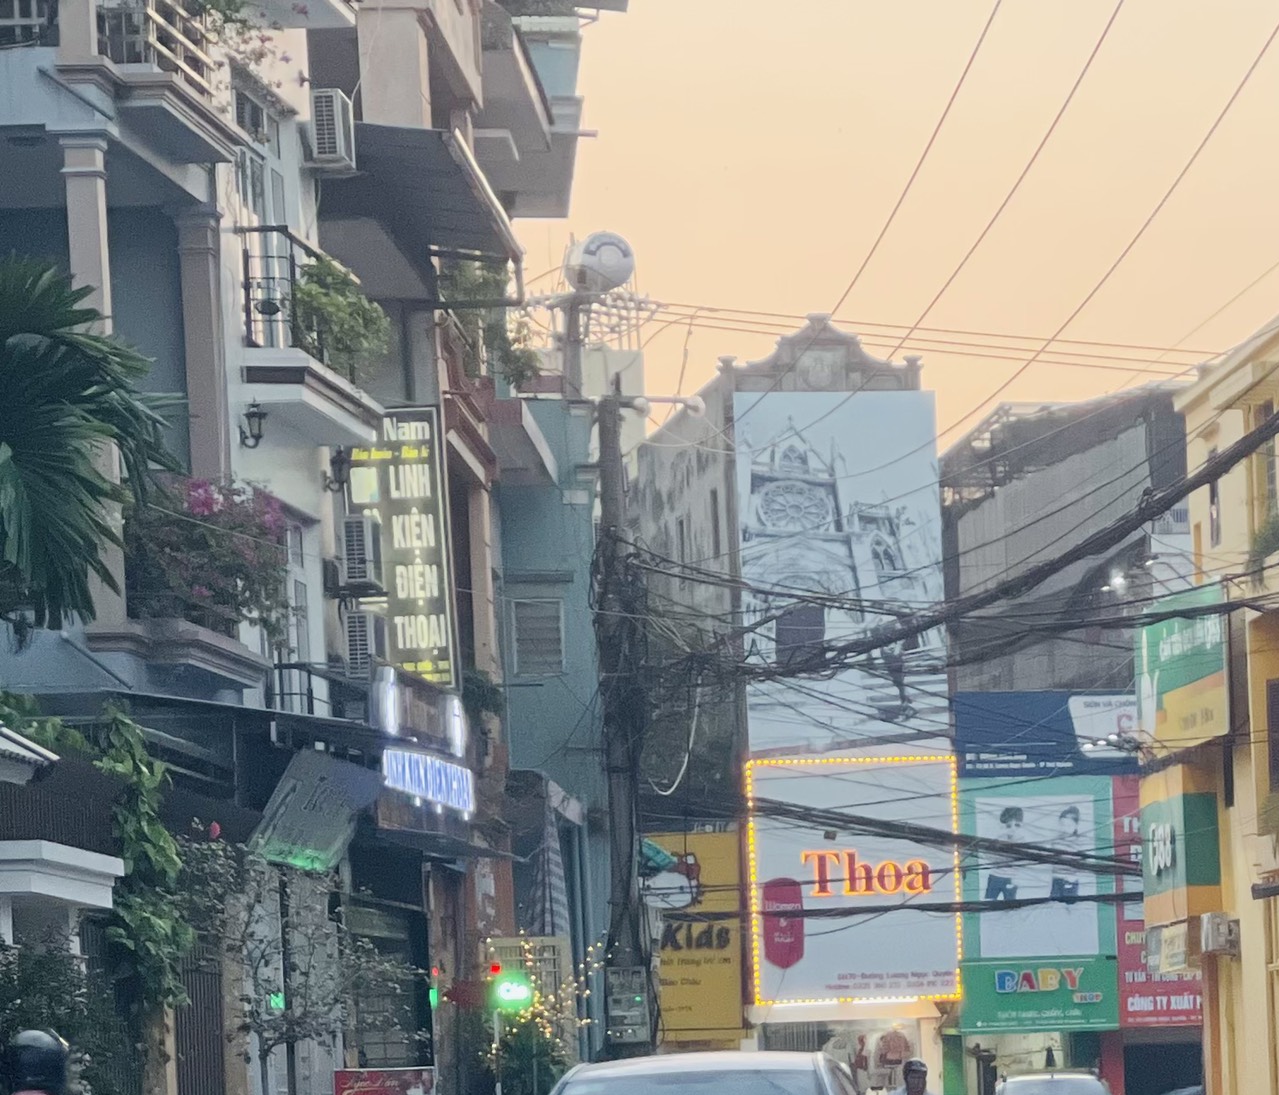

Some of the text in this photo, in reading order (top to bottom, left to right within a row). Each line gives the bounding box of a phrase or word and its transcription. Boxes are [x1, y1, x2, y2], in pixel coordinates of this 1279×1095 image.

[383, 417, 431, 441] Nam
[389, 464, 431, 499] LINH
[392, 507, 435, 555] KIỆN
[396, 558, 438, 606] ĐIỆN
[394, 613, 446, 655] THOẠI
[801, 851, 932, 897] Thoa
[661, 923, 730, 950] Kids
[995, 967, 1084, 993] BABY
[1127, 993, 1154, 1012] CÔNG
[1155, 995, 1168, 1011] TY
[1170, 991, 1194, 1010] XUẤT
